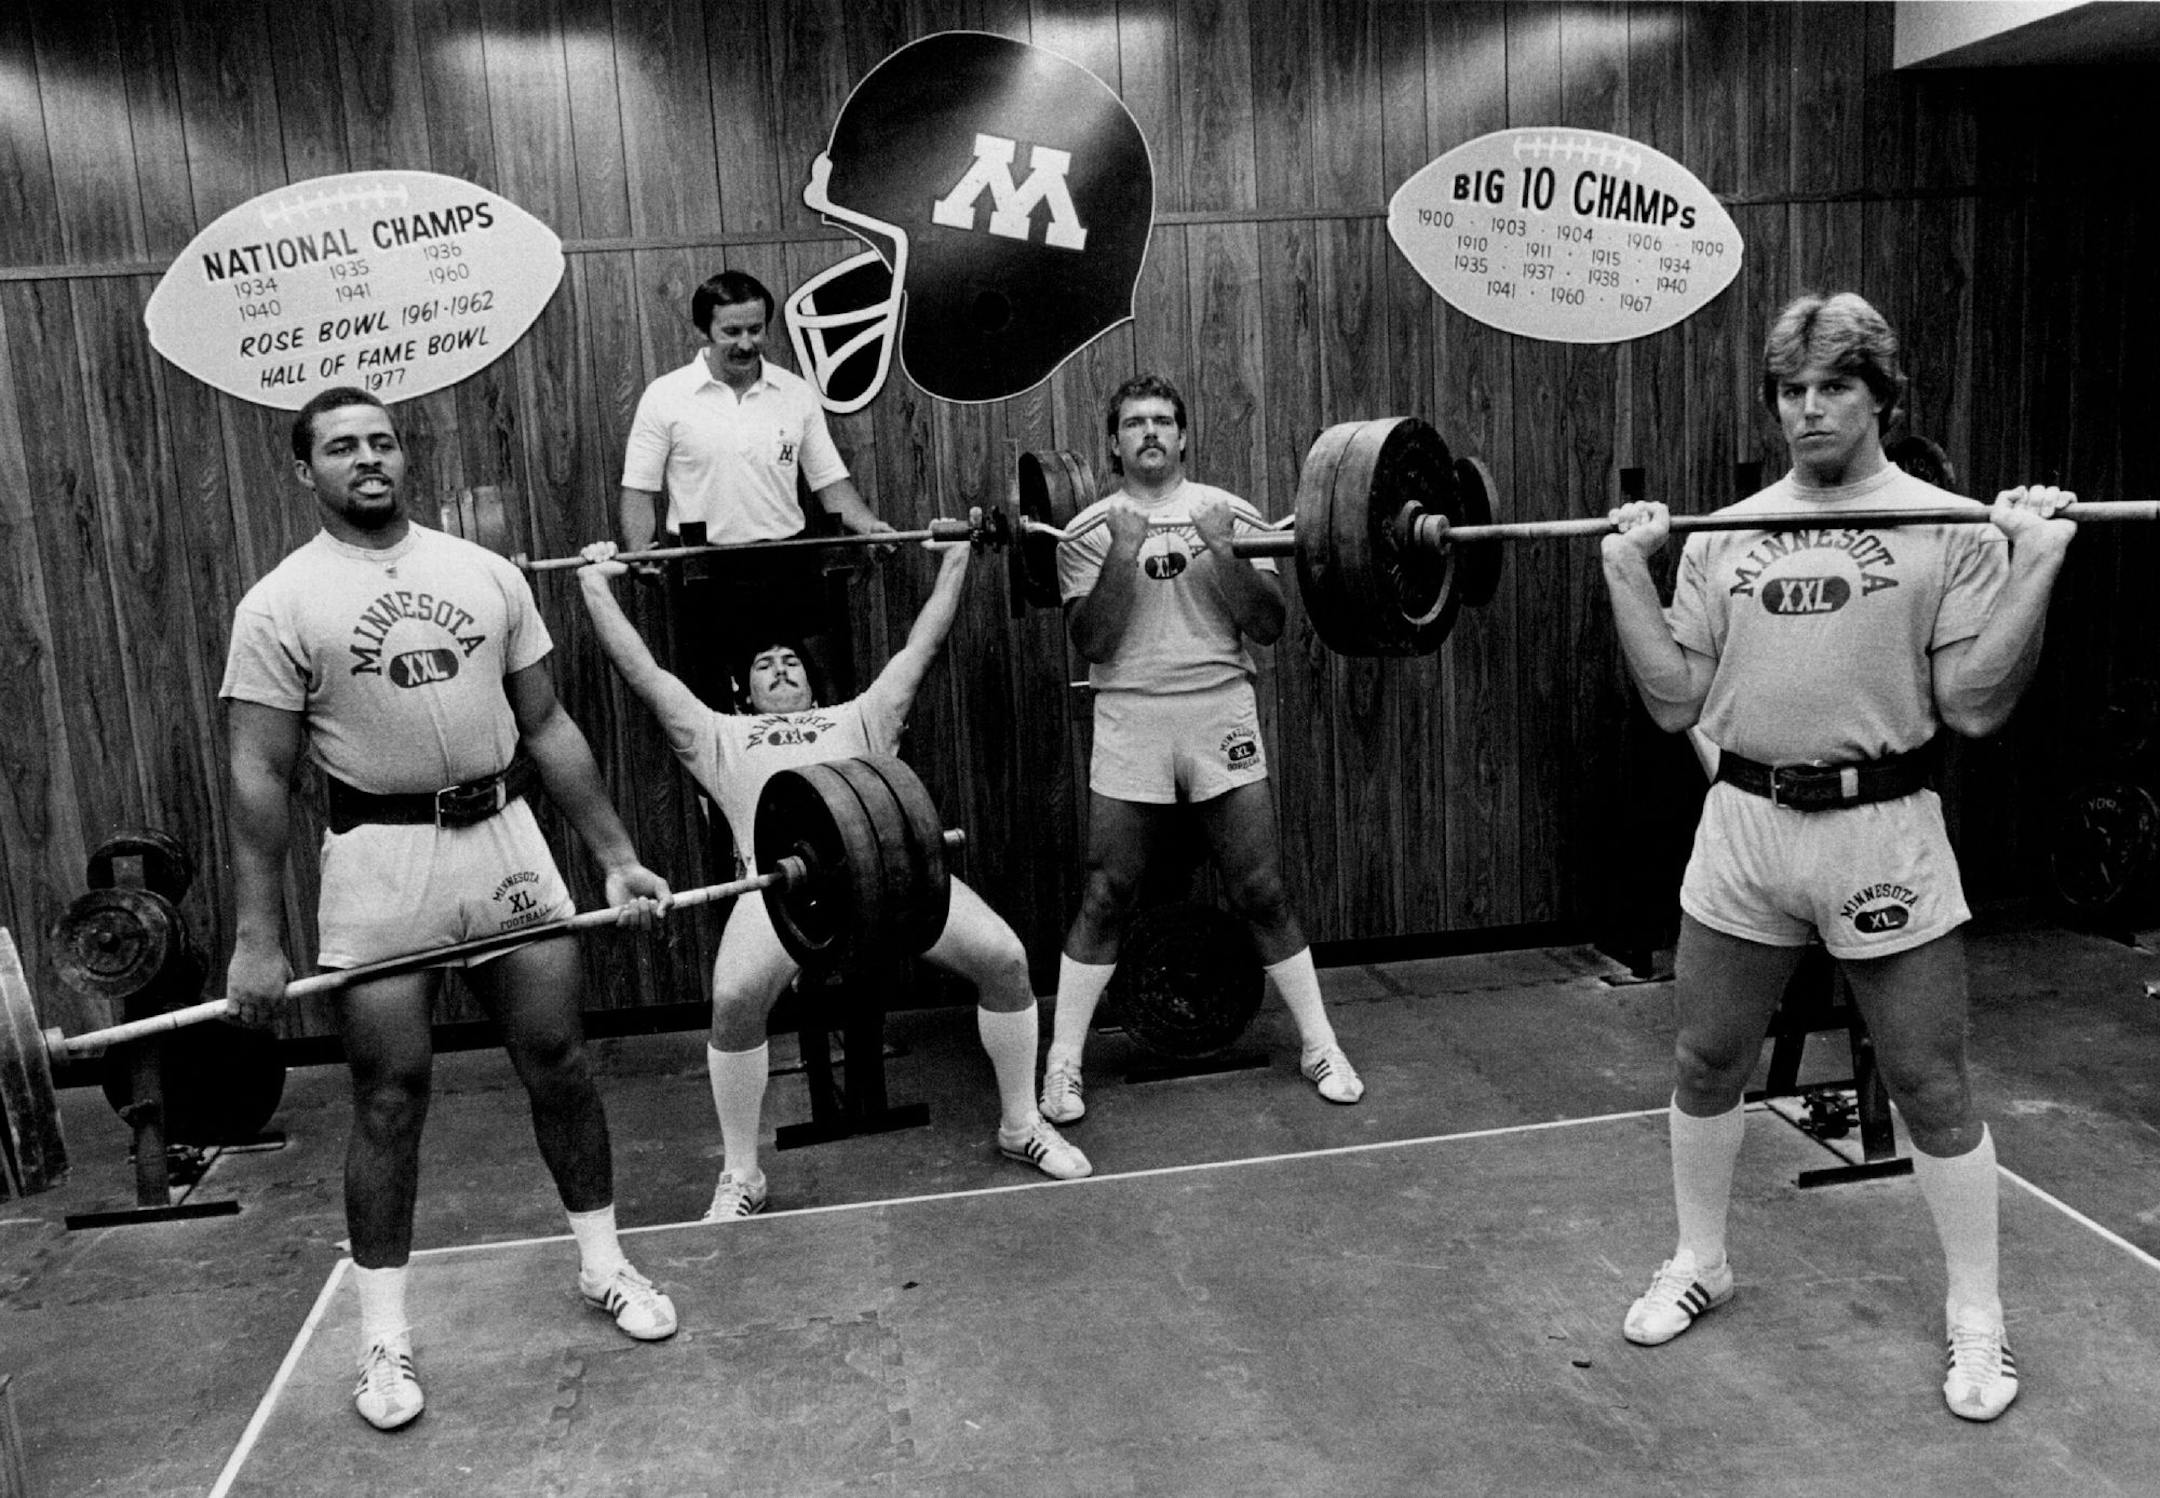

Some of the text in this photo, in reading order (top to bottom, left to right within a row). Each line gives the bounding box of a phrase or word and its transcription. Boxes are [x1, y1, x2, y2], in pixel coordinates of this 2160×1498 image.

[931, 132, 1088, 251] M
[1453, 168, 1505, 204] BIG
[1521, 166, 1555, 211] 10
[202, 201, 494, 282] NATIONAL CHAMPS
[1418, 208, 1725, 257] 1900 1903 1904 1906 1909
[233, 241, 463, 299] 1934 1935 1936
[1454, 254, 1688, 295] 1935 1937 1938 1940
[1457, 235, 1691, 274] 1910 1911 1915 1934
[239, 262, 470, 322] 1940 1941 1960
[1487, 280, 1653, 313] 1941 1960 1967
[240, 327, 304, 357] ROSE
[319, 310, 390, 343] BOWL
[260, 325, 490, 388] HALL OF FAME BOWL
[365, 367, 406, 391] 1977
[1777, 579, 1834, 613] XXL
[350, 591, 487, 677] MINNESOTA
[400, 651, 450, 687] XXL
[1234, 745, 1251, 759] XL
[509, 891, 537, 914] XL
[1840, 883, 1919, 920] MINNESOTA
[1869, 911, 1899, 929] XL
